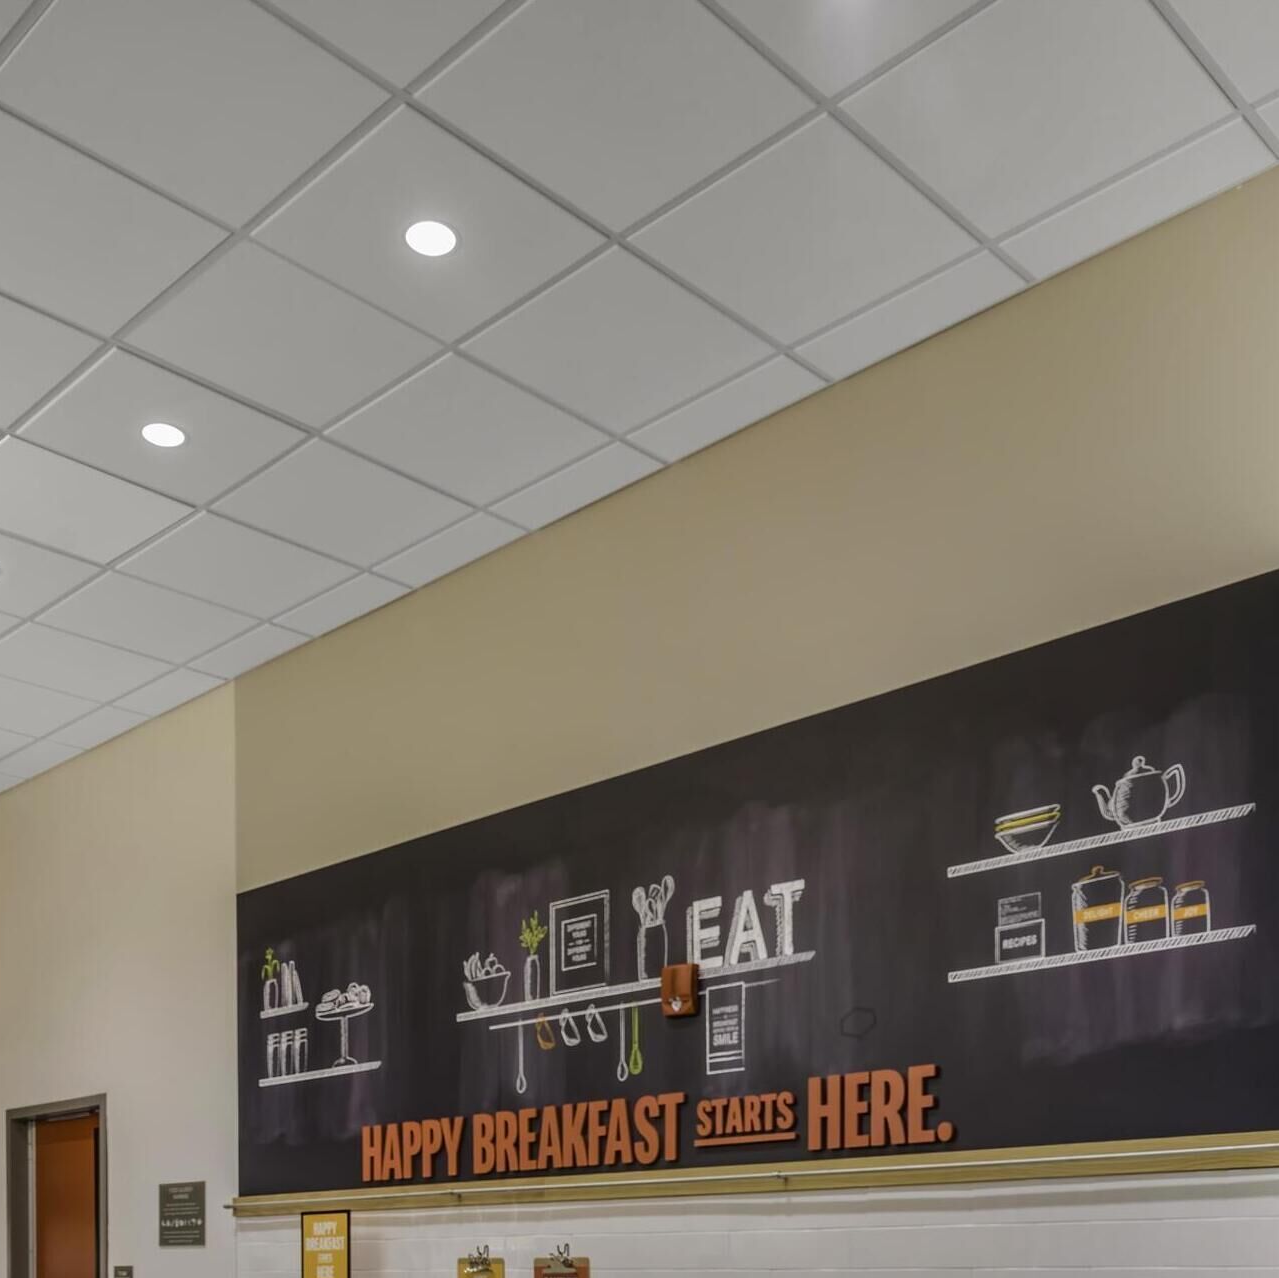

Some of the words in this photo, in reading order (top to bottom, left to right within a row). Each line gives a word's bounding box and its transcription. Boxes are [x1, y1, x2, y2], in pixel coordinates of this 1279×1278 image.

[686, 879, 805, 968] EAT
[1002, 934, 1038, 950] RECIPES
[713, 1031, 739, 1046] SMILE
[361, 1116, 464, 1182] HAPPY
[472, 1092, 685, 1175] BREAKFAST
[695, 1091, 794, 1137] STARTS
[807, 1064, 954, 1151] HERE.
[313, 1222, 337, 1236] HAPPY
[317, 1265, 335, 1278] HERE
